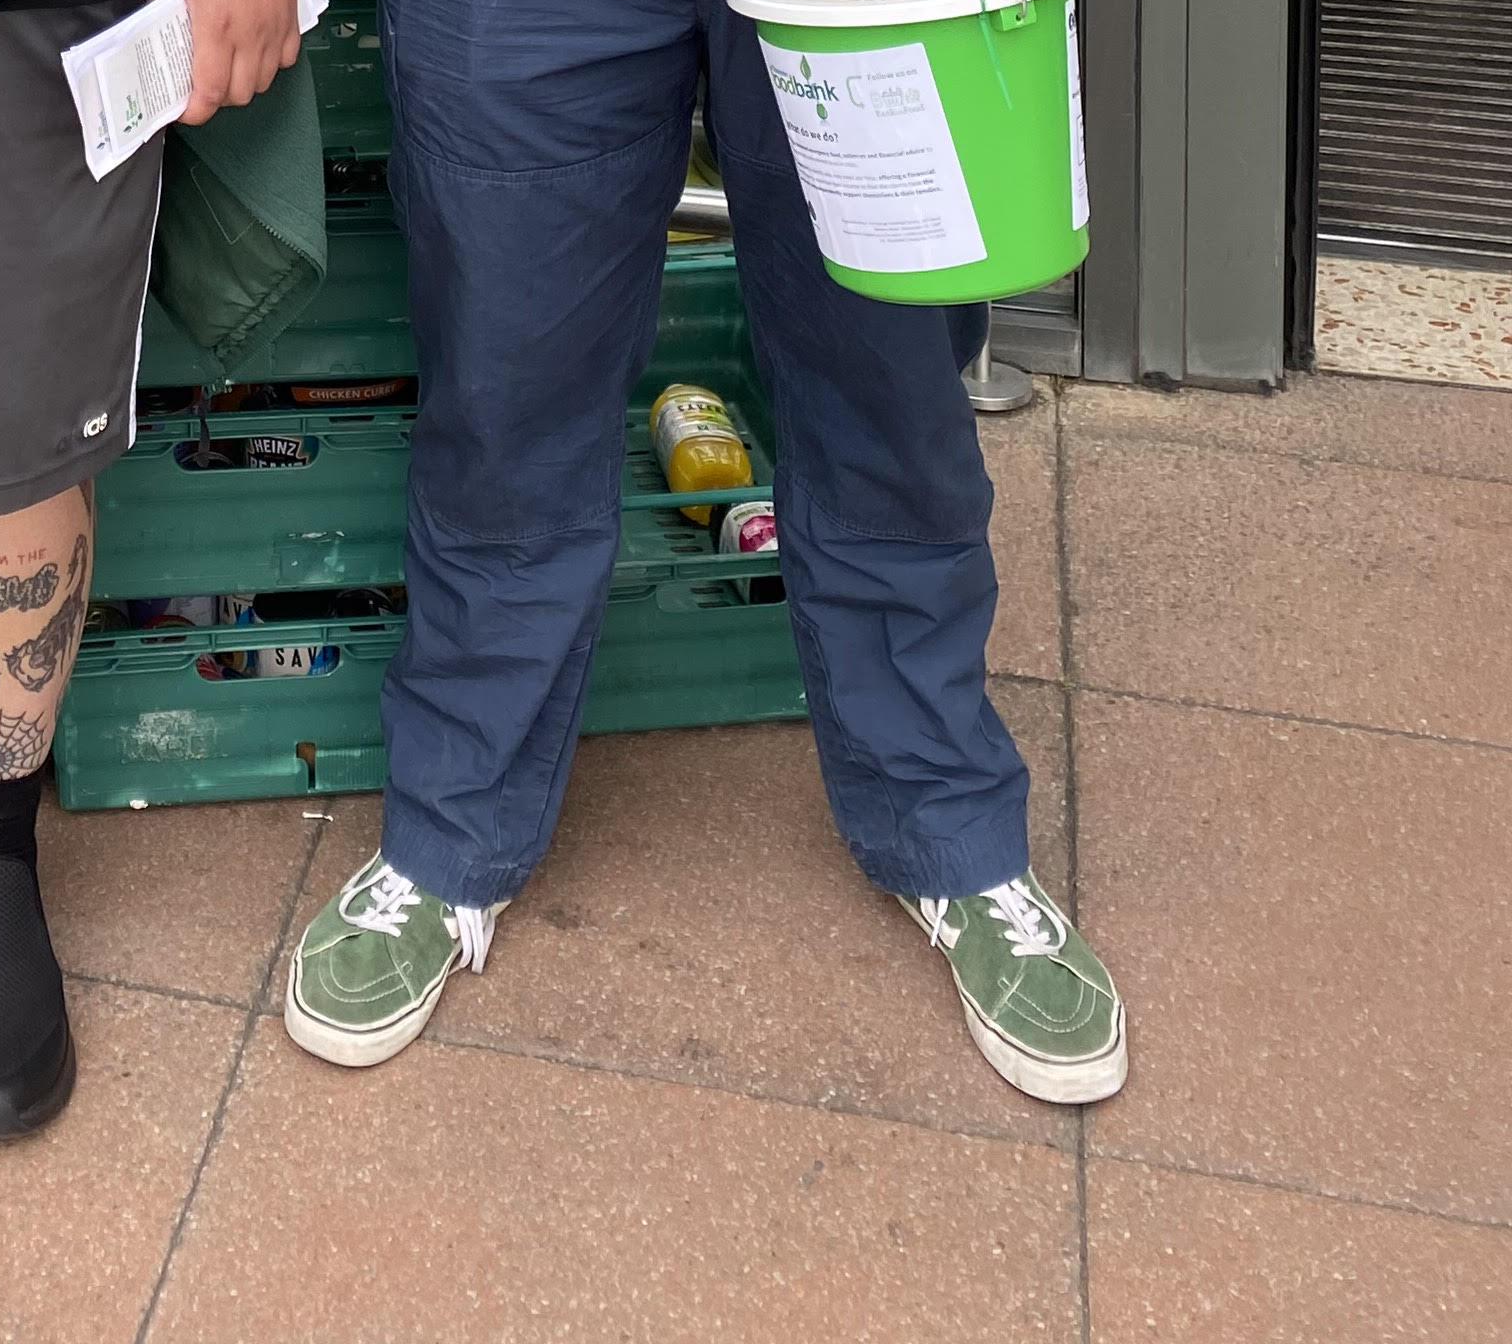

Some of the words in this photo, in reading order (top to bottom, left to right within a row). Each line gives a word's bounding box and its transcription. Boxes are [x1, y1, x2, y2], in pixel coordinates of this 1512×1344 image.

[810, 131, 822, 141] we
[823, 132, 839, 143] do?
[308, 389, 361, 400] CHICKEN
[254, 439, 297, 457] HEINZ
[17, 548, 48, 565] THE
